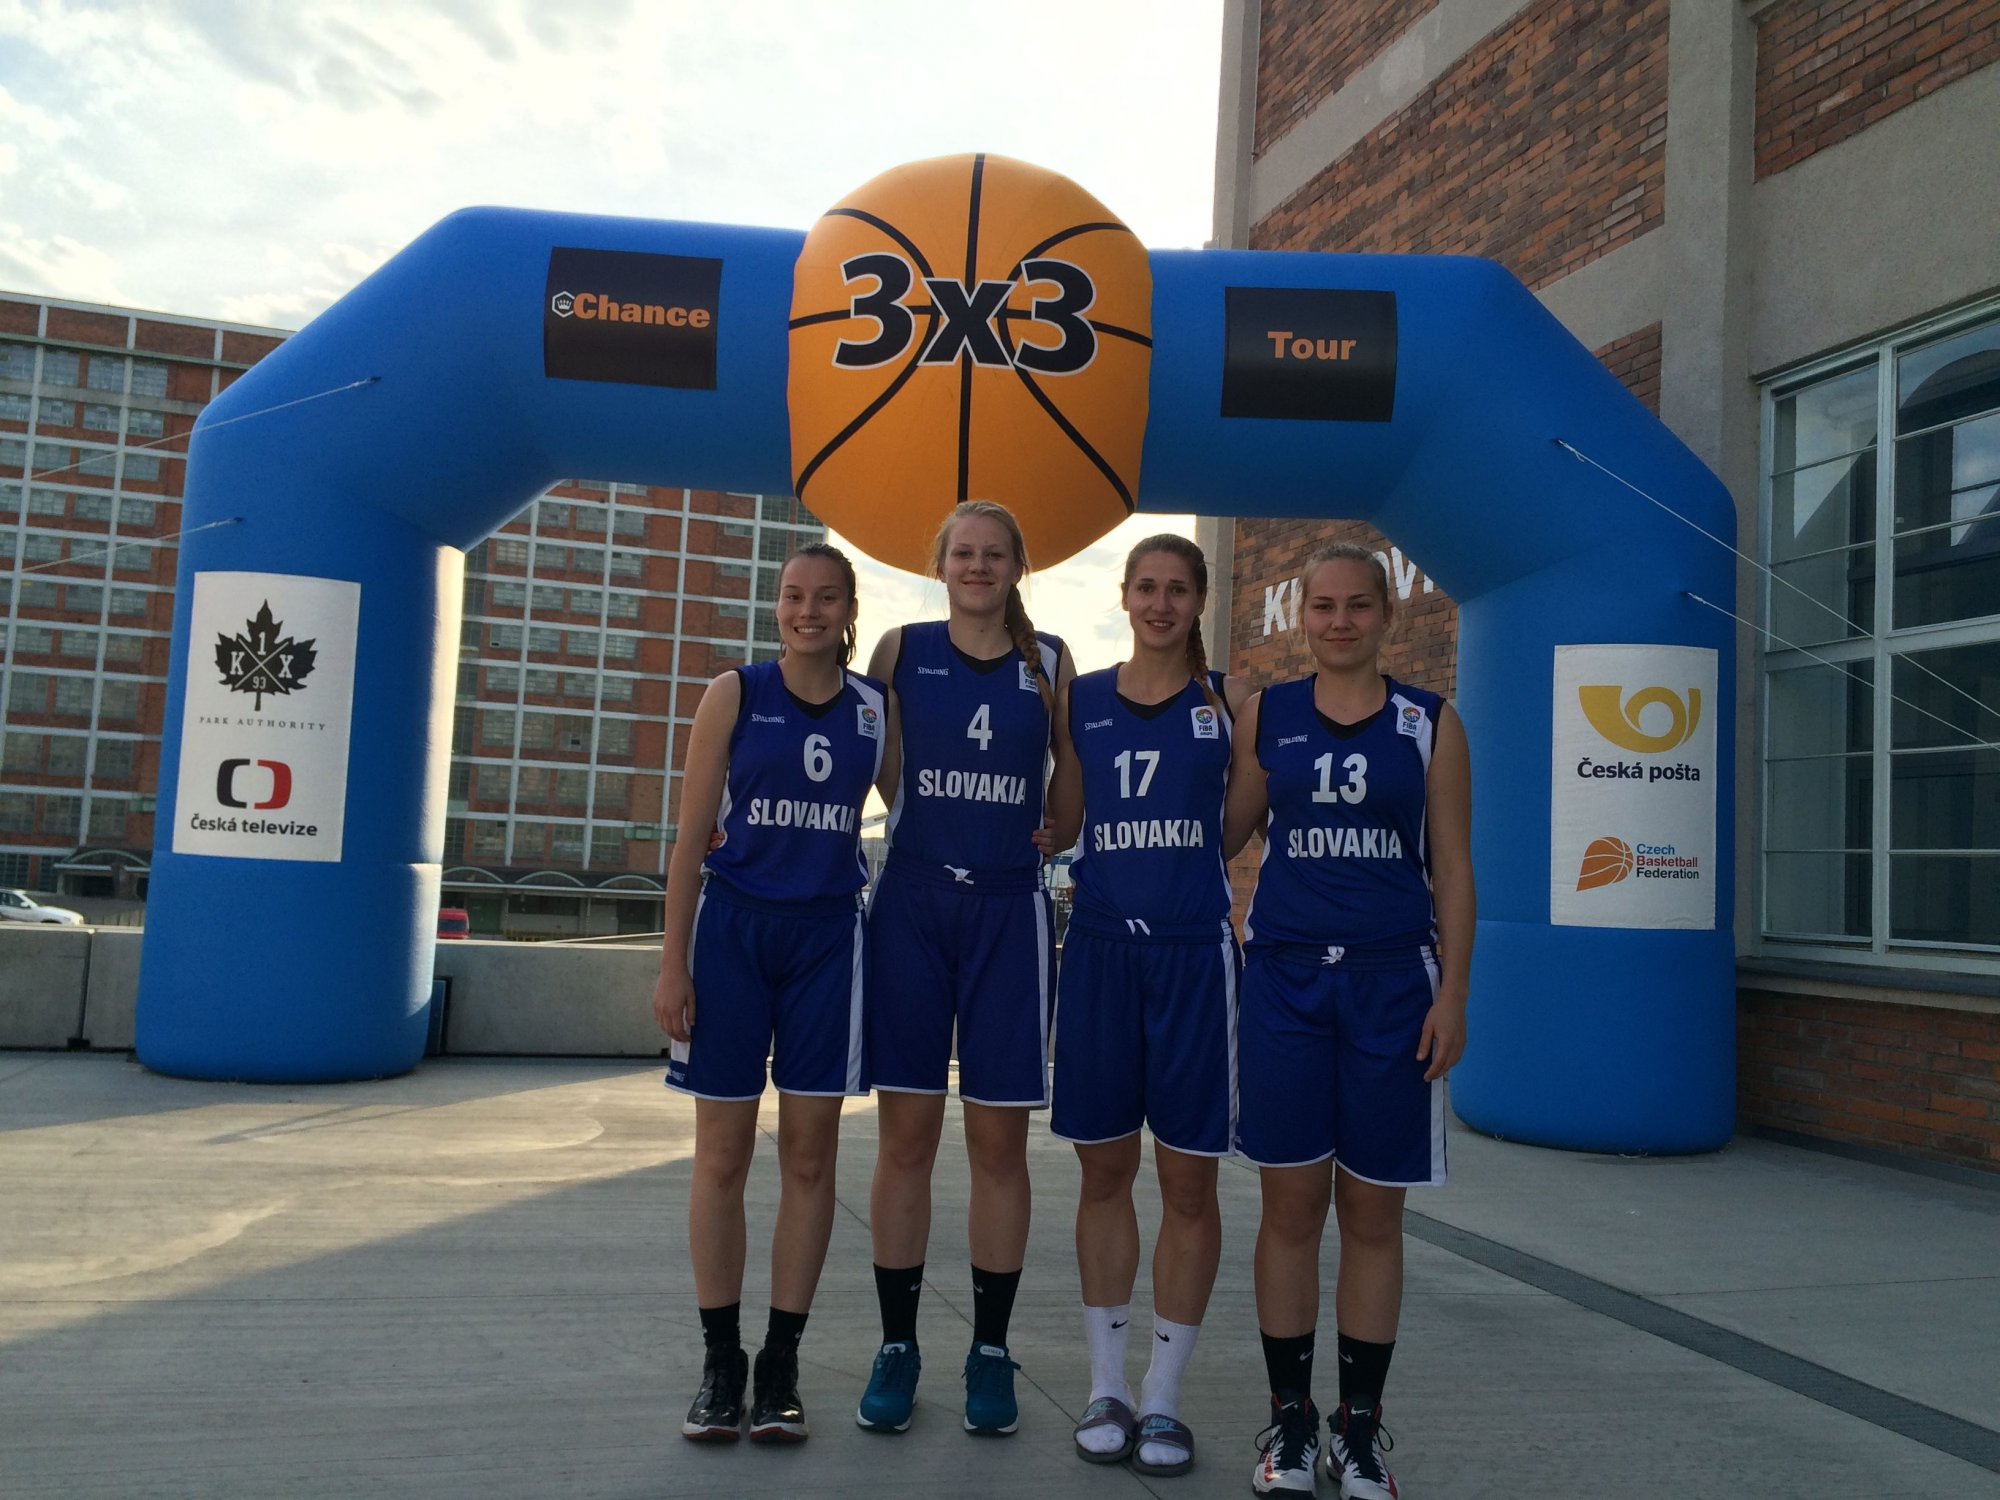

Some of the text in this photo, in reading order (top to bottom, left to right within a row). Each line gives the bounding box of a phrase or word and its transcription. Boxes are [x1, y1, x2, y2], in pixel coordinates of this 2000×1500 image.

[573, 292, 711, 328] Chance
[832, 252, 1098, 376] 3x3
[1267, 331, 1357, 360] Tour
[917, 666, 950, 676] SPALDING
[252, 676, 267, 690] 93
[199, 716, 326, 731] PARK AUTHORITY
[751, 713, 785, 724] SPALDING
[967, 703, 993, 751] 4
[1084, 718, 1113, 731] SPALDING
[1198, 724, 1214, 732] FIBA
[1402, 721, 1417, 731] FIBA
[1278, 734, 1308, 747] SPALDING
[803, 733, 833, 782] 6
[1114, 750, 1160, 798] 17
[1312, 752, 1368, 805] 13
[1577, 756, 1700, 783] Česká pošta
[918, 768, 1027, 806] SLOVAKIA
[190, 813, 318, 836] Česká televize
[747, 797, 856, 835] SLOVAKIA
[1094, 819, 1204, 852] SLOVAKIA
[1287, 827, 1402, 859] SLOVAKIA
[1636, 843, 1675, 855] Czech
[1636, 855, 1698, 867] Basketball
[1636, 867, 1700, 880] Federation
[1147, 1416, 1177, 1429] NIKE
